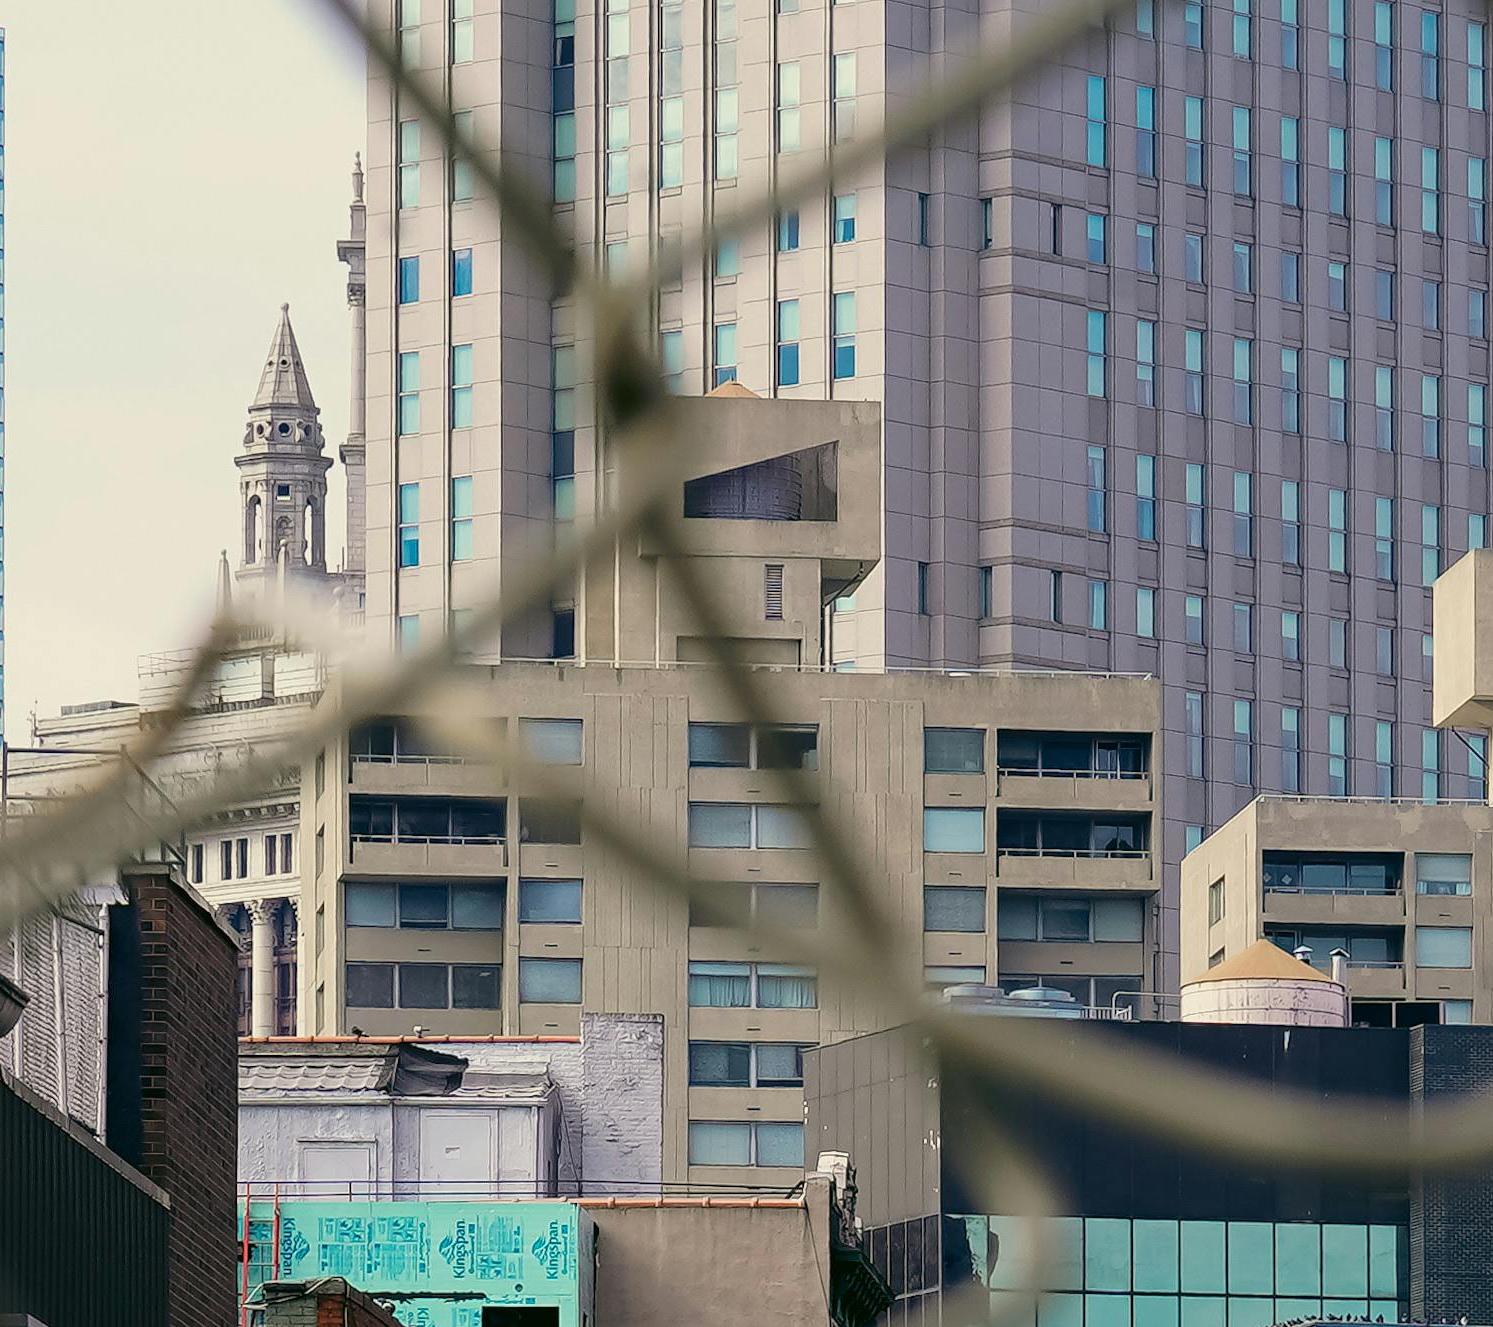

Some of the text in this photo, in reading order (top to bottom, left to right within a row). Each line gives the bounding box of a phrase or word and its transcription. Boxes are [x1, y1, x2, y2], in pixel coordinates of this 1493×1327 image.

[282, 1216, 296, 1277] Kingspan
[453, 1219, 470, 1279] Kingspan
[545, 1220, 558, 1280] Kingspan
